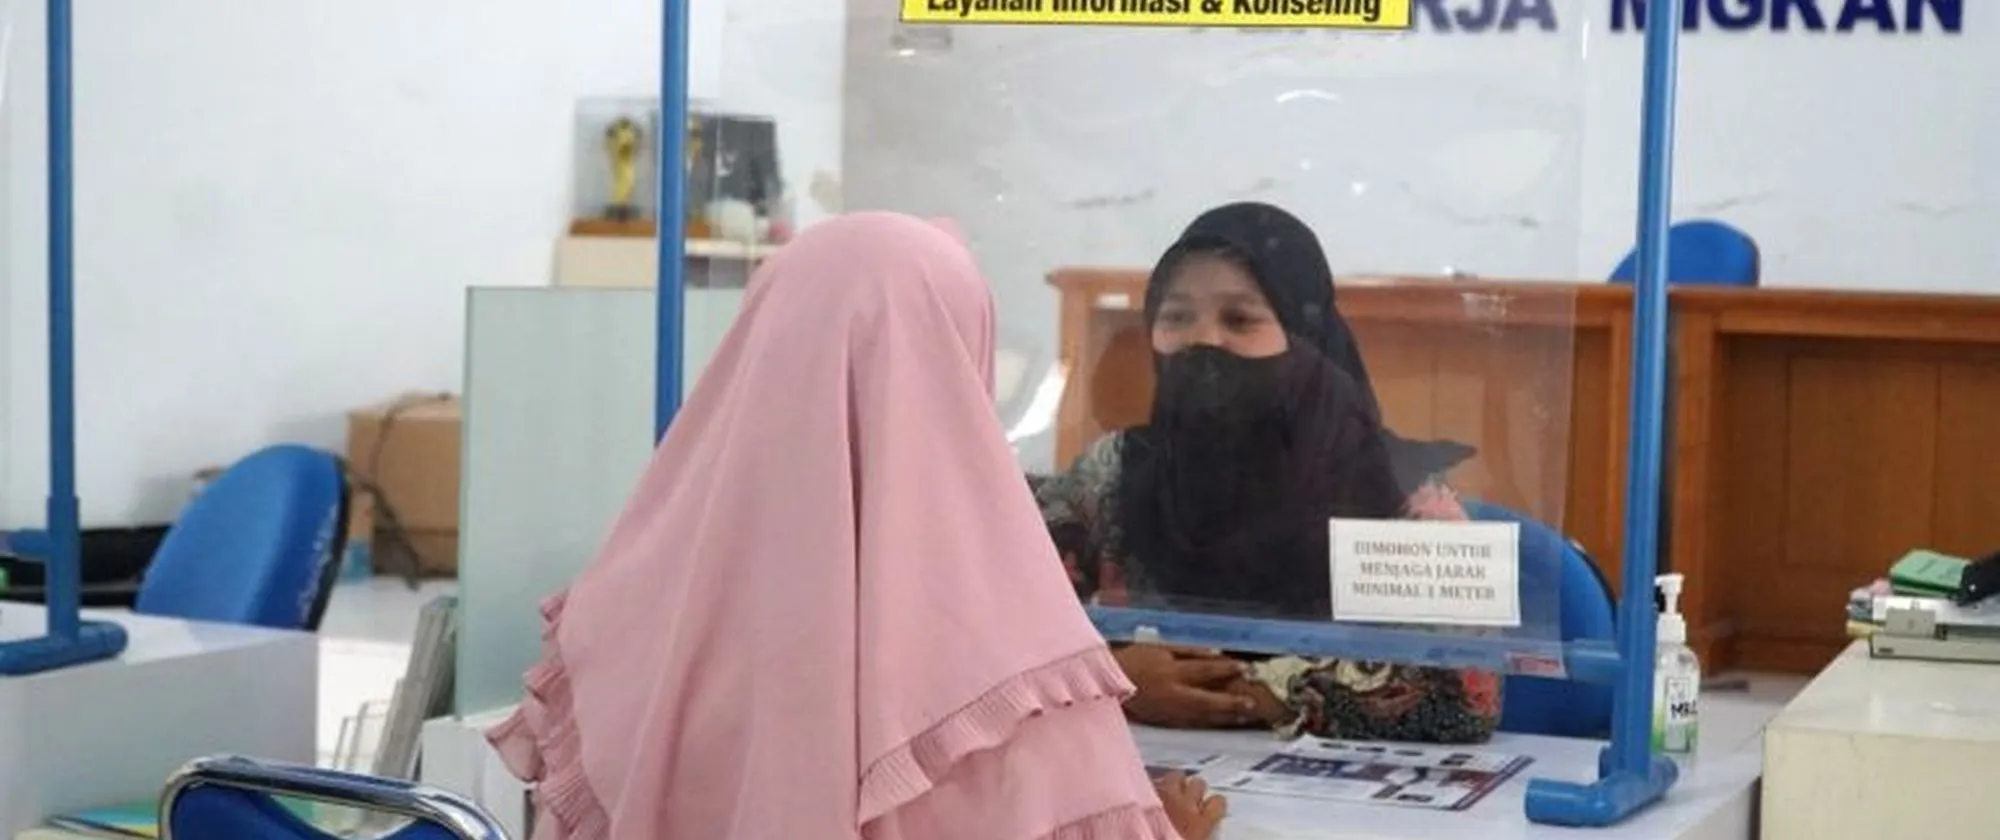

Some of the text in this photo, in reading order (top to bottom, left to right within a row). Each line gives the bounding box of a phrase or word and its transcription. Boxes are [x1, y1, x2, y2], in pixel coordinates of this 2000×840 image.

[1200, 0, 1224, 14] &
[1353, 540, 1432, 557] DIMOHON
[1359, 561, 1486, 580] MENJAGA JARAK
[1352, 581, 1421, 598] MINIMAL
[1439, 585, 1496, 601] METER
